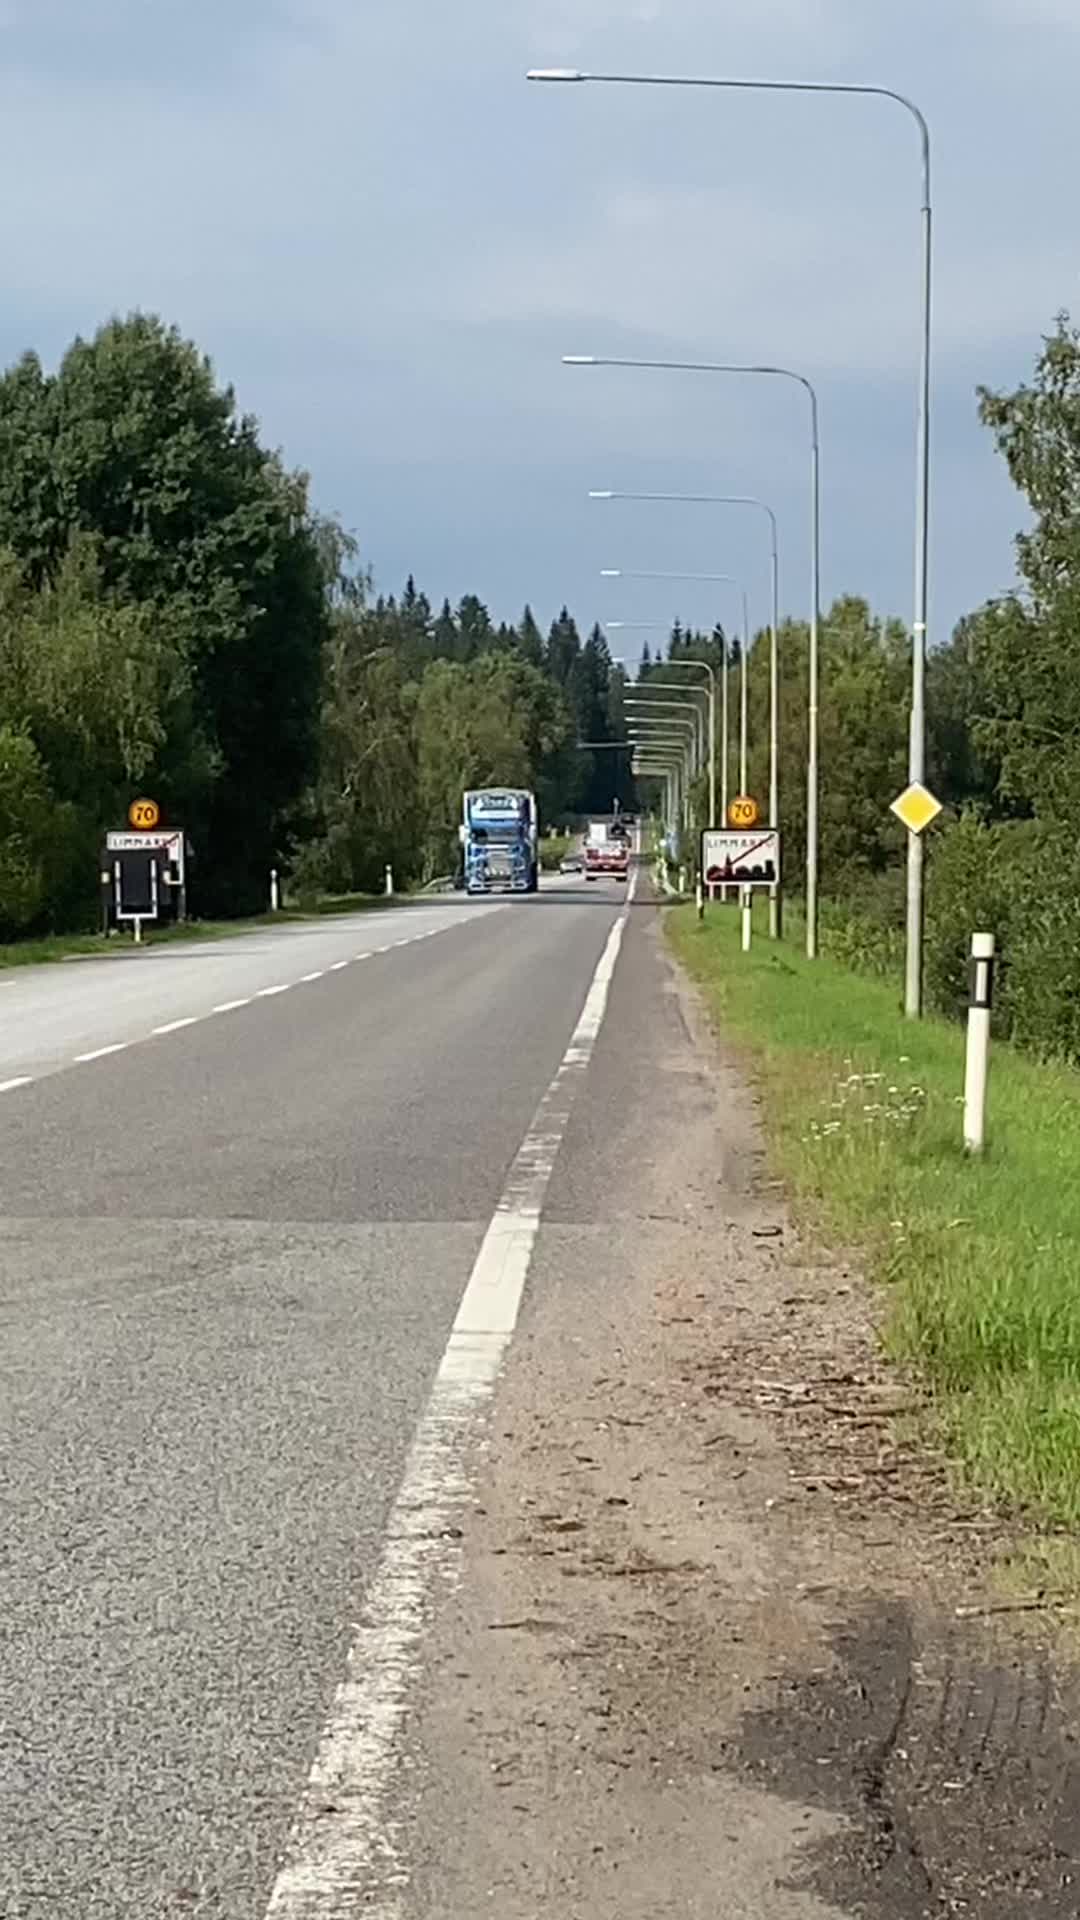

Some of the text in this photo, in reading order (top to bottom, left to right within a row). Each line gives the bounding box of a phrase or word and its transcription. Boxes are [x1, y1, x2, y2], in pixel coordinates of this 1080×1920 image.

[136, 807, 154, 821] 70
[735, 804, 753, 818] 70
[113, 838, 177, 847] LIMMAR
[707, 839, 775, 848] LIMMAR
